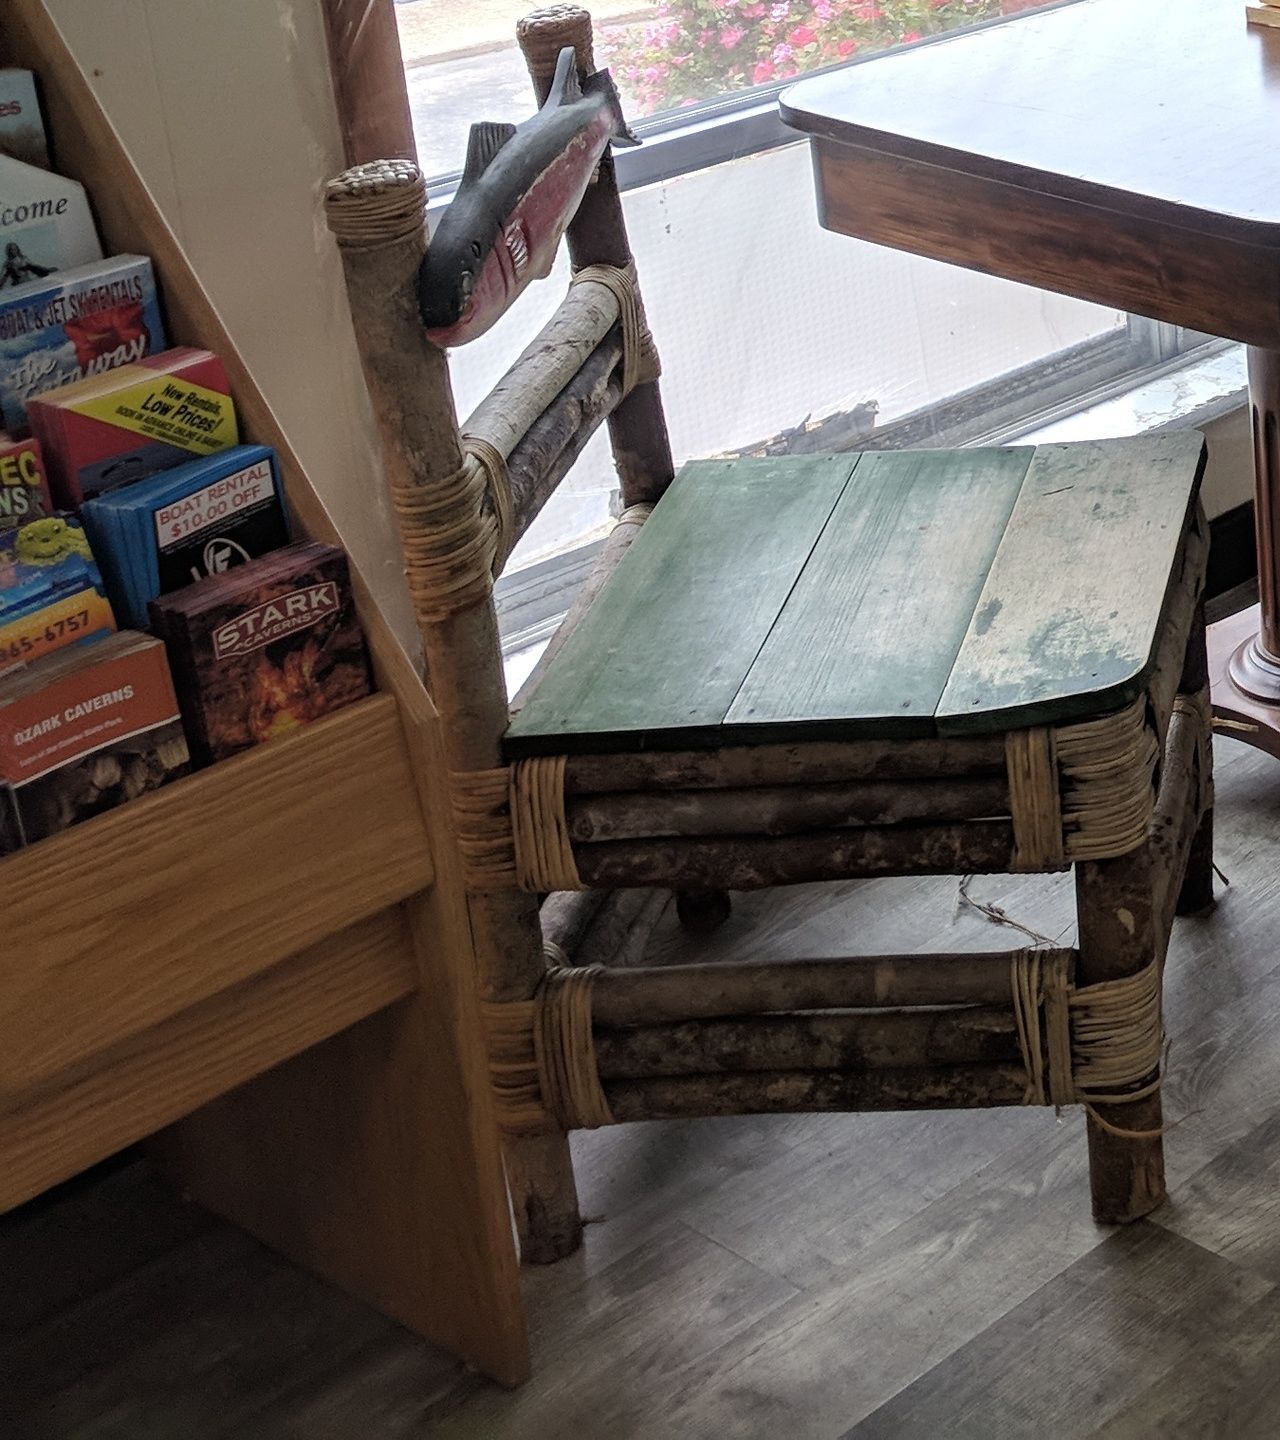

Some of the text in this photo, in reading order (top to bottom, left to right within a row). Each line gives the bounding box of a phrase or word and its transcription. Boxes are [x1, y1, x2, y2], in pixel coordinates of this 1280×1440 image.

[141, 393, 224, 434] Low Prices!
[163, 383, 185, 399] New
[158, 467, 269, 526] BOAT RENTAL
[169, 484, 261, 538] $10.00 OFF
[215, 586, 334, 651] STARK
[243, 614, 315, 650] CAVERNS
[14, 712, 62, 747] OZARK
[64, 685, 135, 722] CAVERNS
